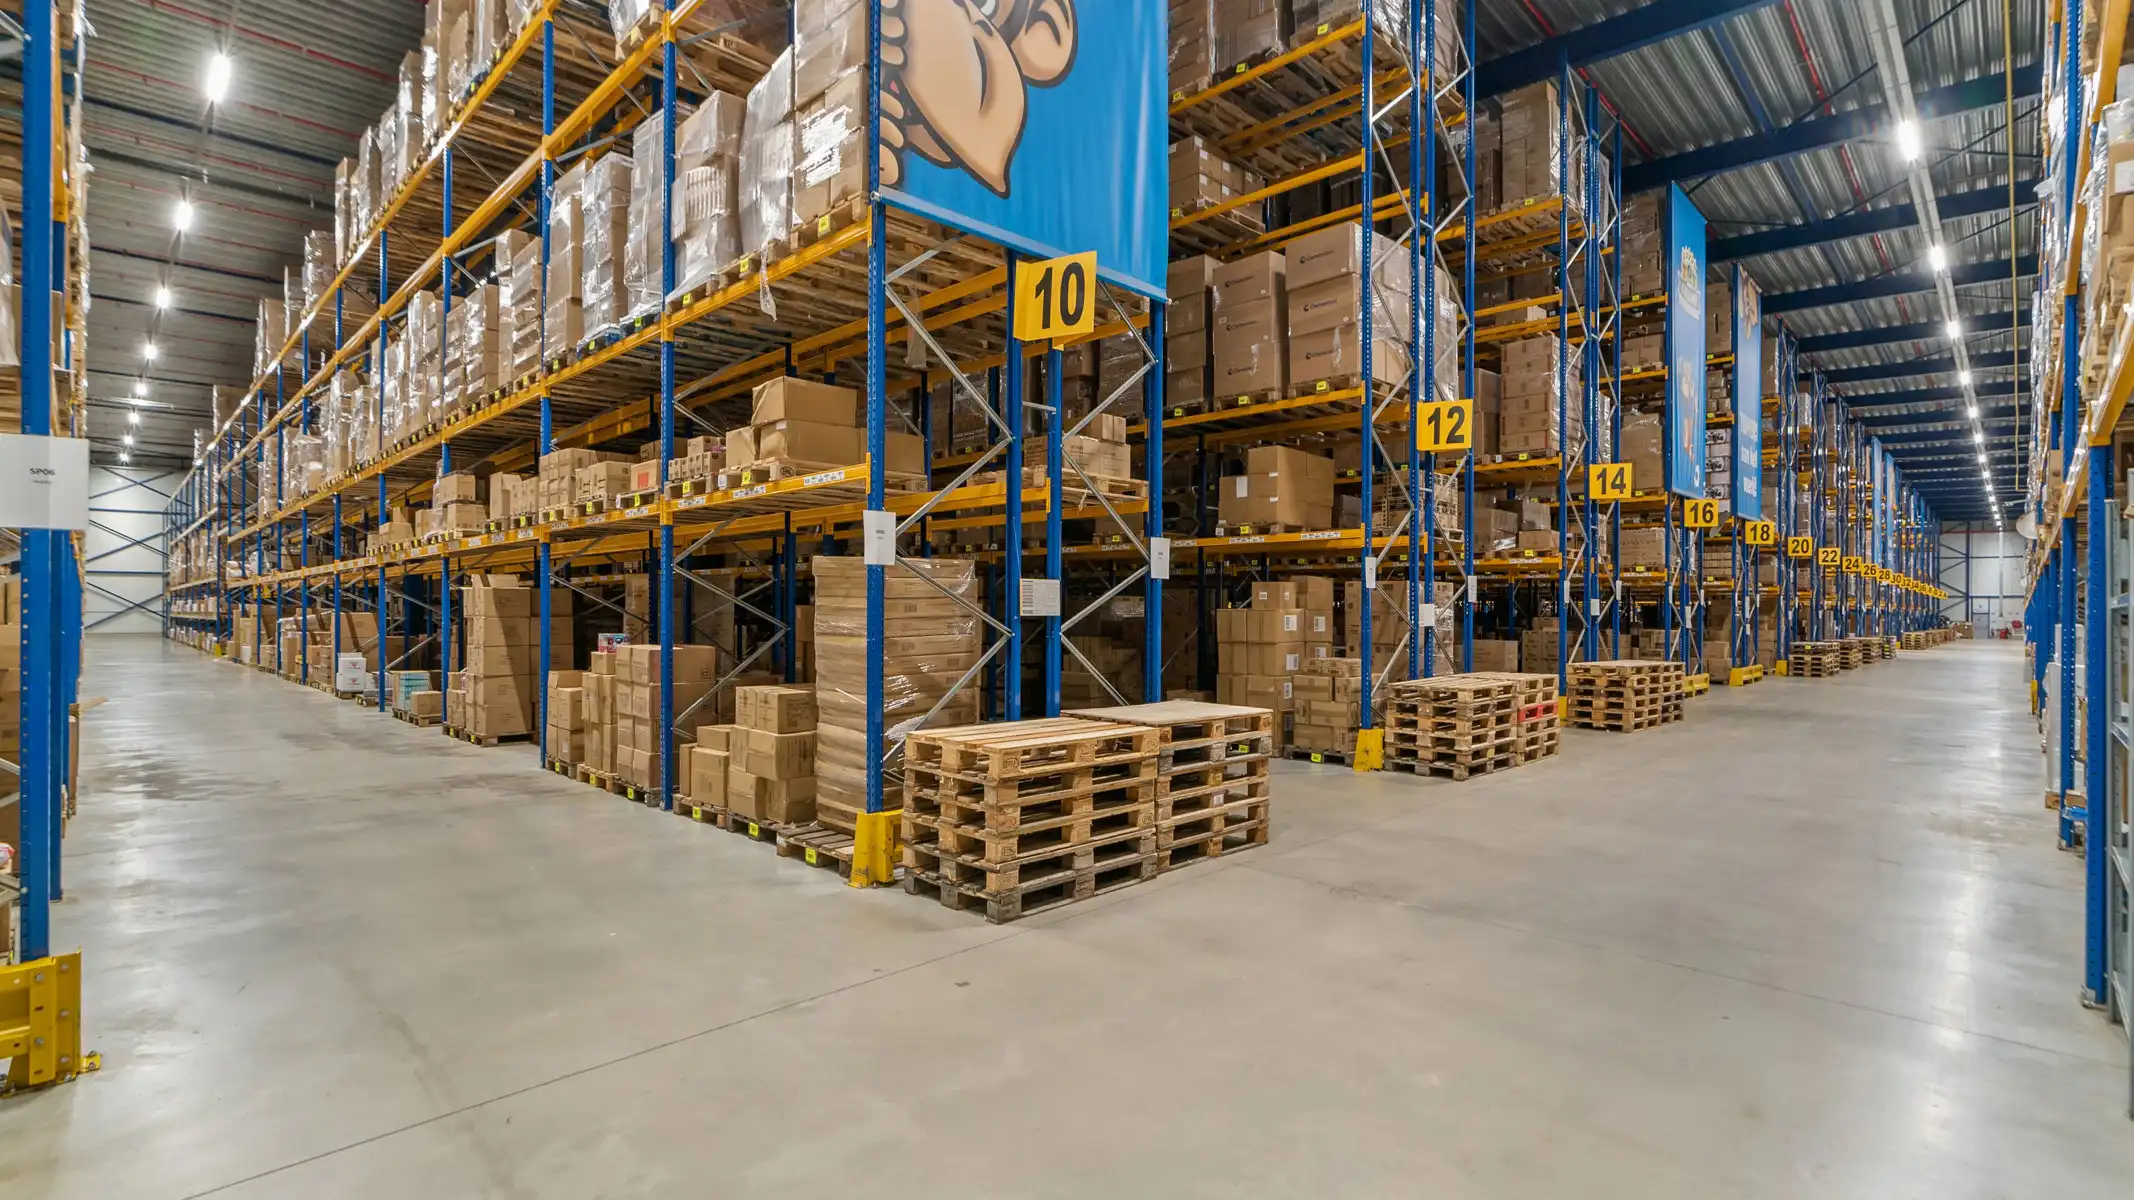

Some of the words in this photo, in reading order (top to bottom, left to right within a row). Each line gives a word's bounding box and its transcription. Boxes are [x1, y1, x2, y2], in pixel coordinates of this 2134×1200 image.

[1035, 262, 1085, 330] 10
[1428, 405, 1466, 445] 12
[1596, 467, 1627, 495] 14
[1690, 502, 1714, 524] 16
[1750, 524, 1770, 541] 18
[1792, 539, 1809, 554] 20
[1821, 550, 1837, 563] 22
[1845, 558, 1859, 570] 24
[1863, 565, 1877, 575] 26
[1878, 570, 1890, 580] 28
